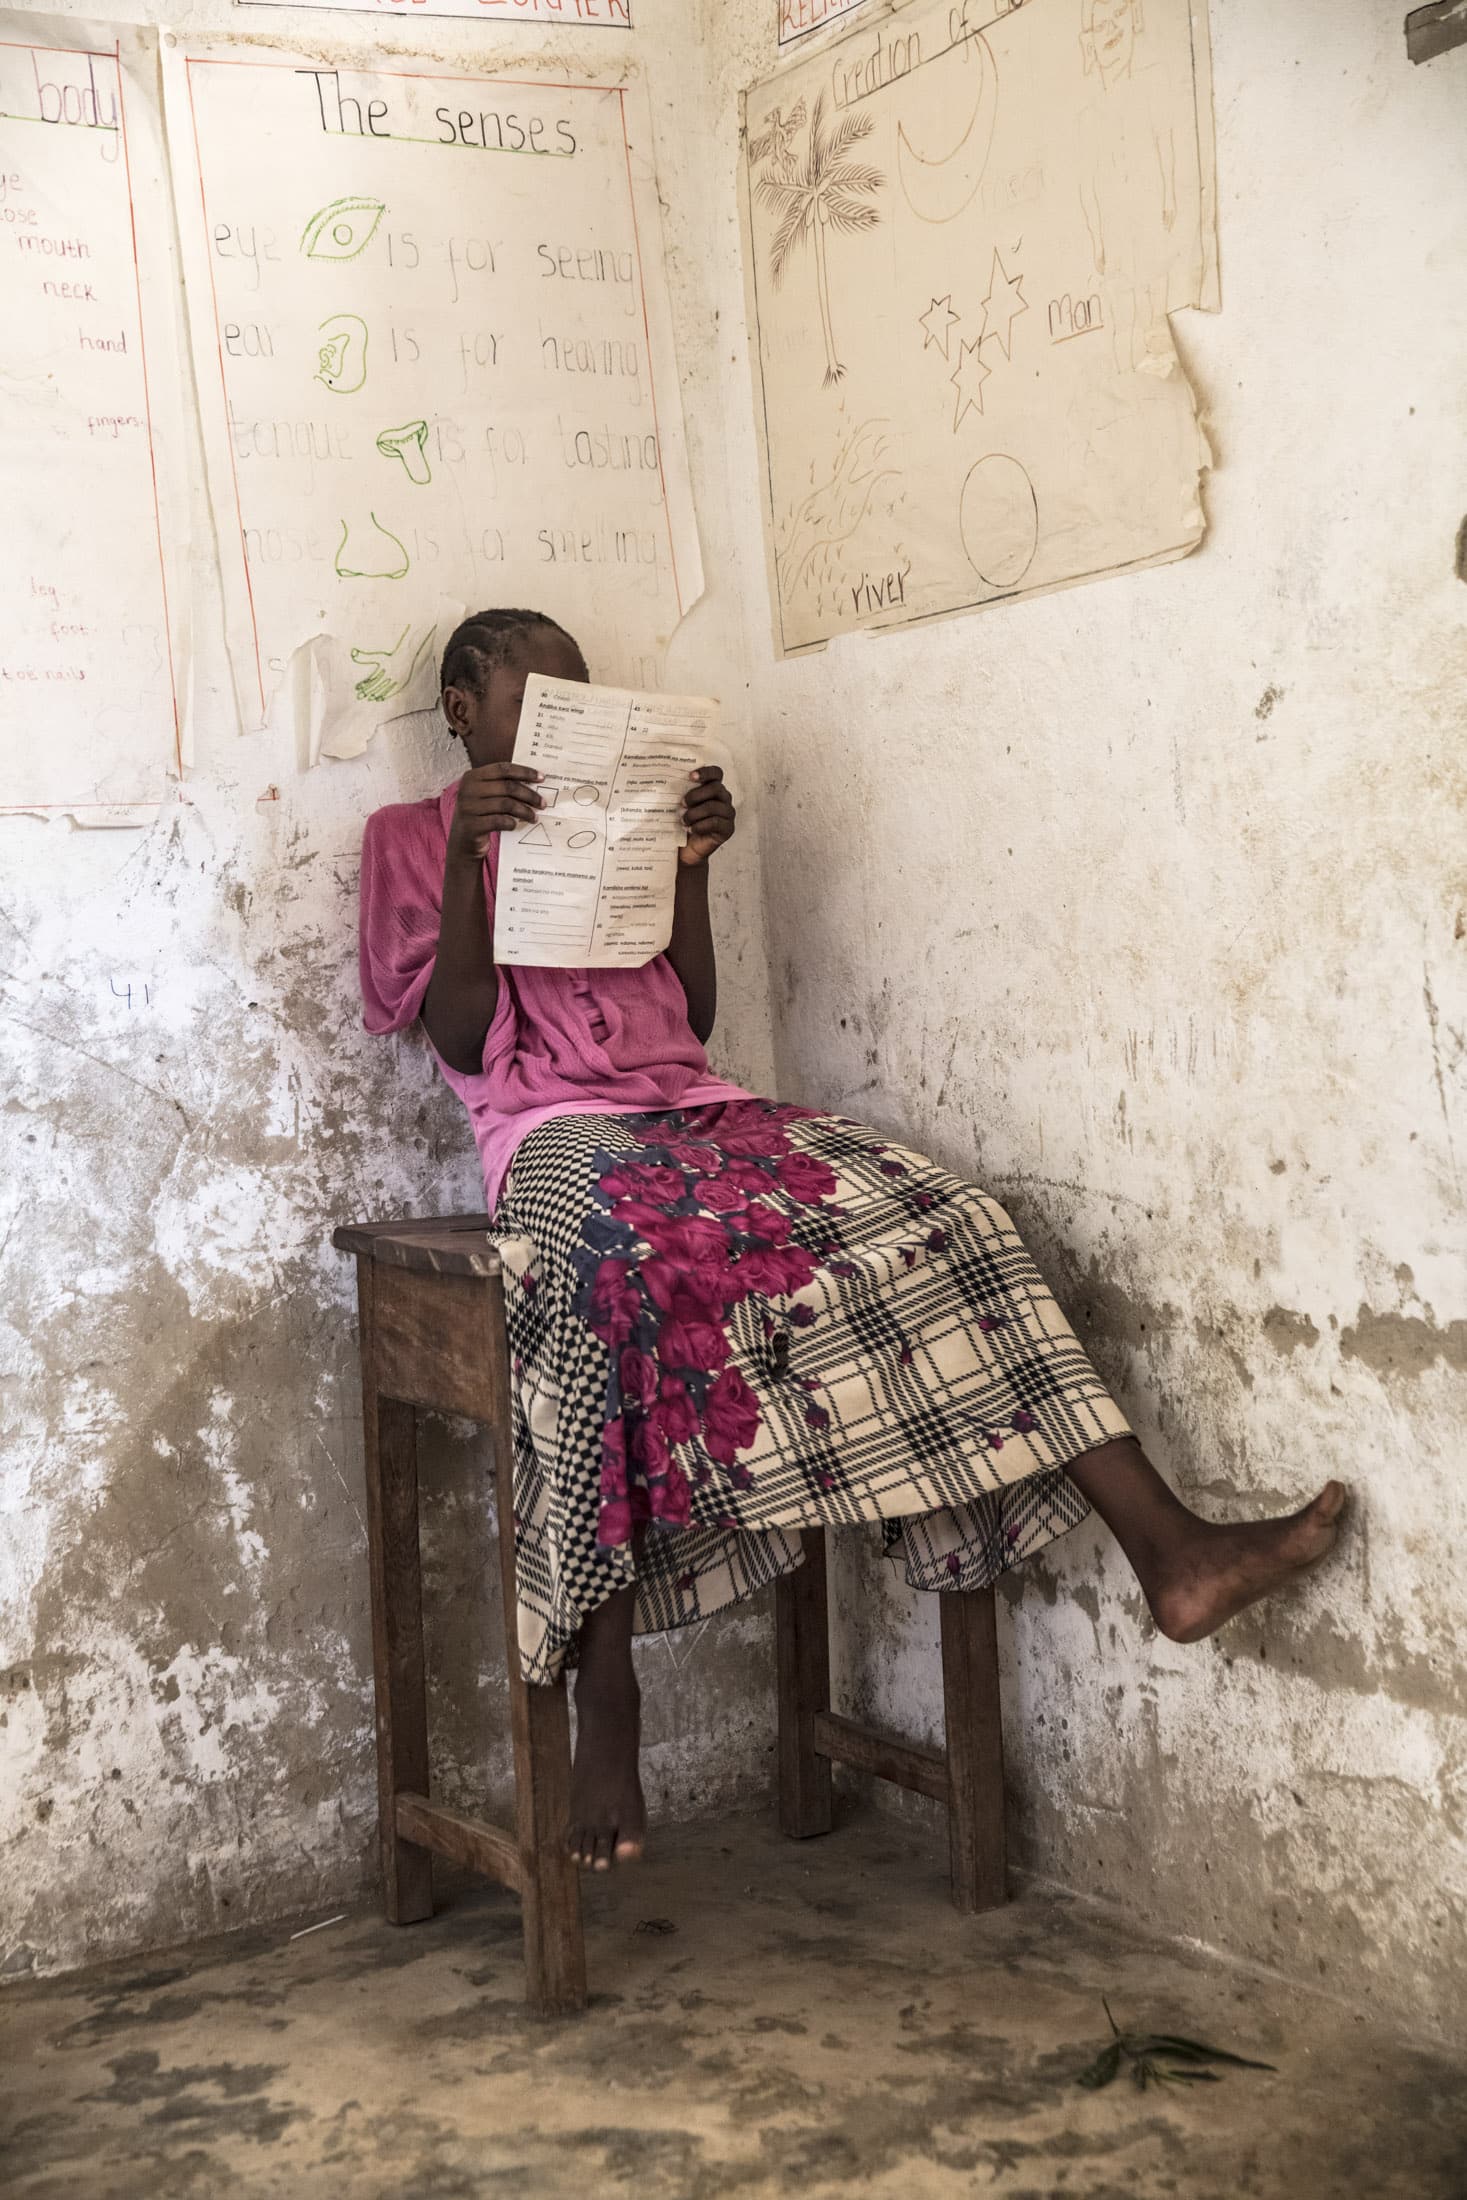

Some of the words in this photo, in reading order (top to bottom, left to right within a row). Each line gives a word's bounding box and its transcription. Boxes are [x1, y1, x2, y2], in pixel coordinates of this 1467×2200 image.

[31, 50, 119, 163] body
[294, 69, 391, 138] The
[17, 234, 91, 259] mouth
[214, 223, 282, 291] eye
[387, 210, 420, 268] is
[444, 237, 503, 303] for
[537, 227, 636, 317] seeing
[43, 280, 98, 302] neck
[78, 327, 128, 353] hand
[224, 322, 278, 358] ear
[389, 304, 420, 363] is
[457, 330, 504, 395] for
[537, 317, 642, 407] hearing
[483, 426, 528, 500] for
[552, 413, 663, 506] tasting
[851, 560, 911, 614] river
[109, 975, 149, 1010] 41
